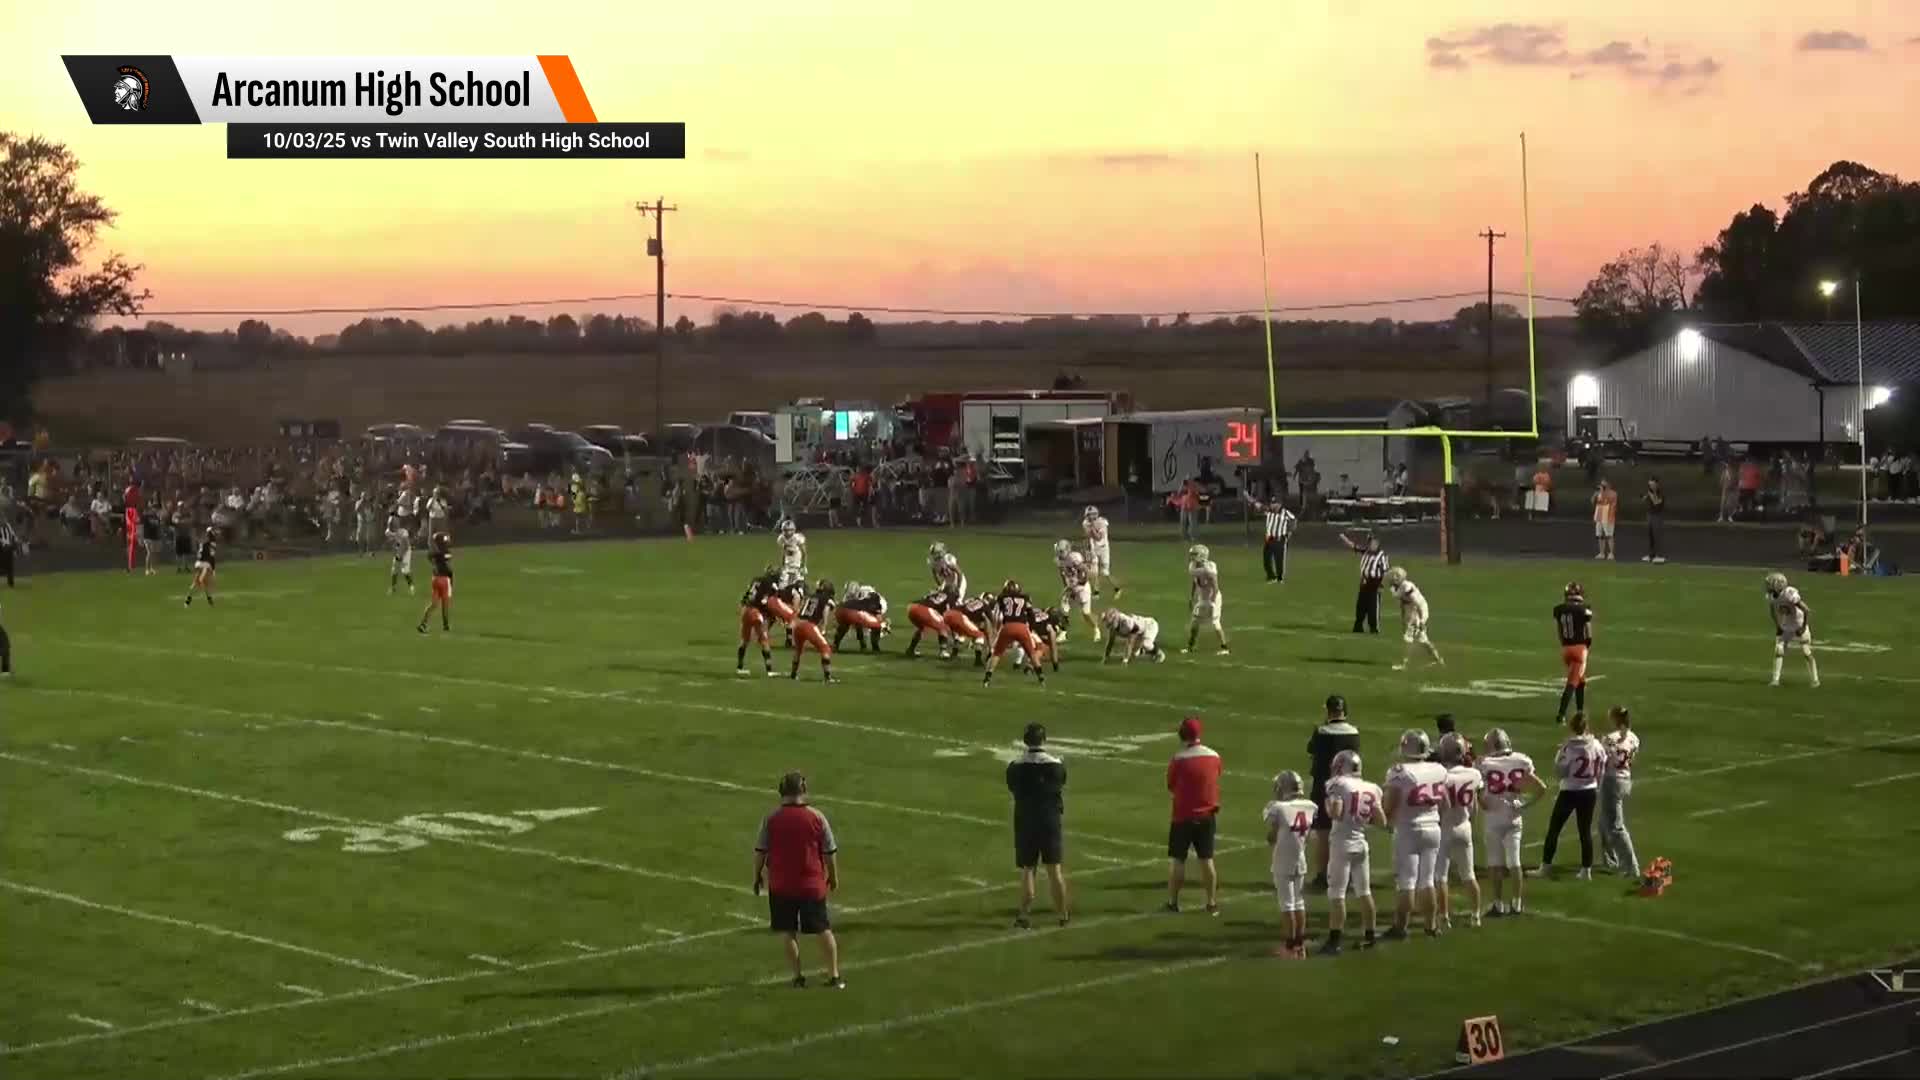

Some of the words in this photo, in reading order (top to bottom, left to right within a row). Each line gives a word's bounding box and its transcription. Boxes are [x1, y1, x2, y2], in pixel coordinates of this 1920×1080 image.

[1225, 421, 1257, 456] 24
[1003, 596, 1025, 617] 37
[1351, 790, 1377, 818] 13
[1408, 782, 1445, 807] 65
[1450, 781, 1474, 808] 16
[1290, 811, 1308, 835] 4
[1470, 1021, 1500, 1059] 30
